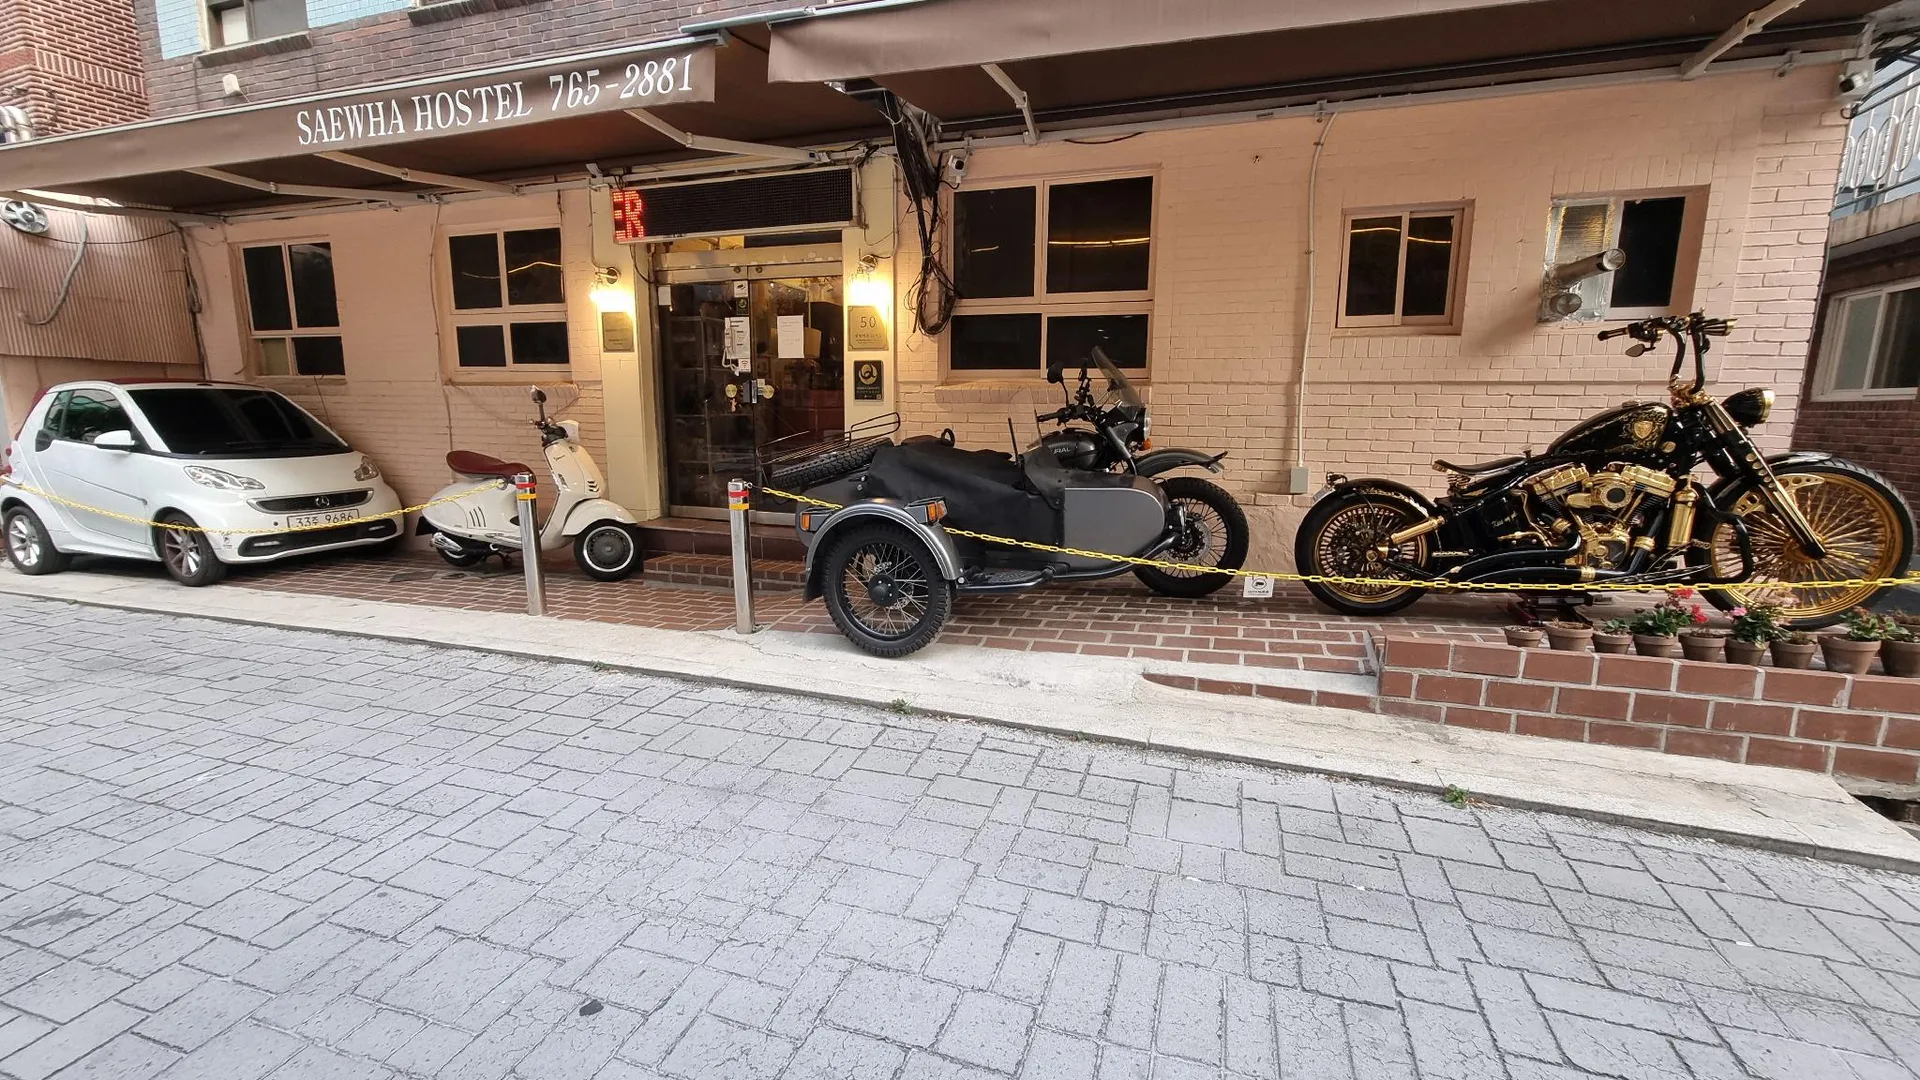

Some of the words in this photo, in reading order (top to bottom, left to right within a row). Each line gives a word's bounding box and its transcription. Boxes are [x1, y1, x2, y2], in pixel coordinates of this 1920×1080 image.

[297, 99, 405, 145] SAEWHA
[411, 81, 533, 132] HOSTEL
[549, 54, 692, 112] 765-2881
[860, 316, 876, 328] 50
